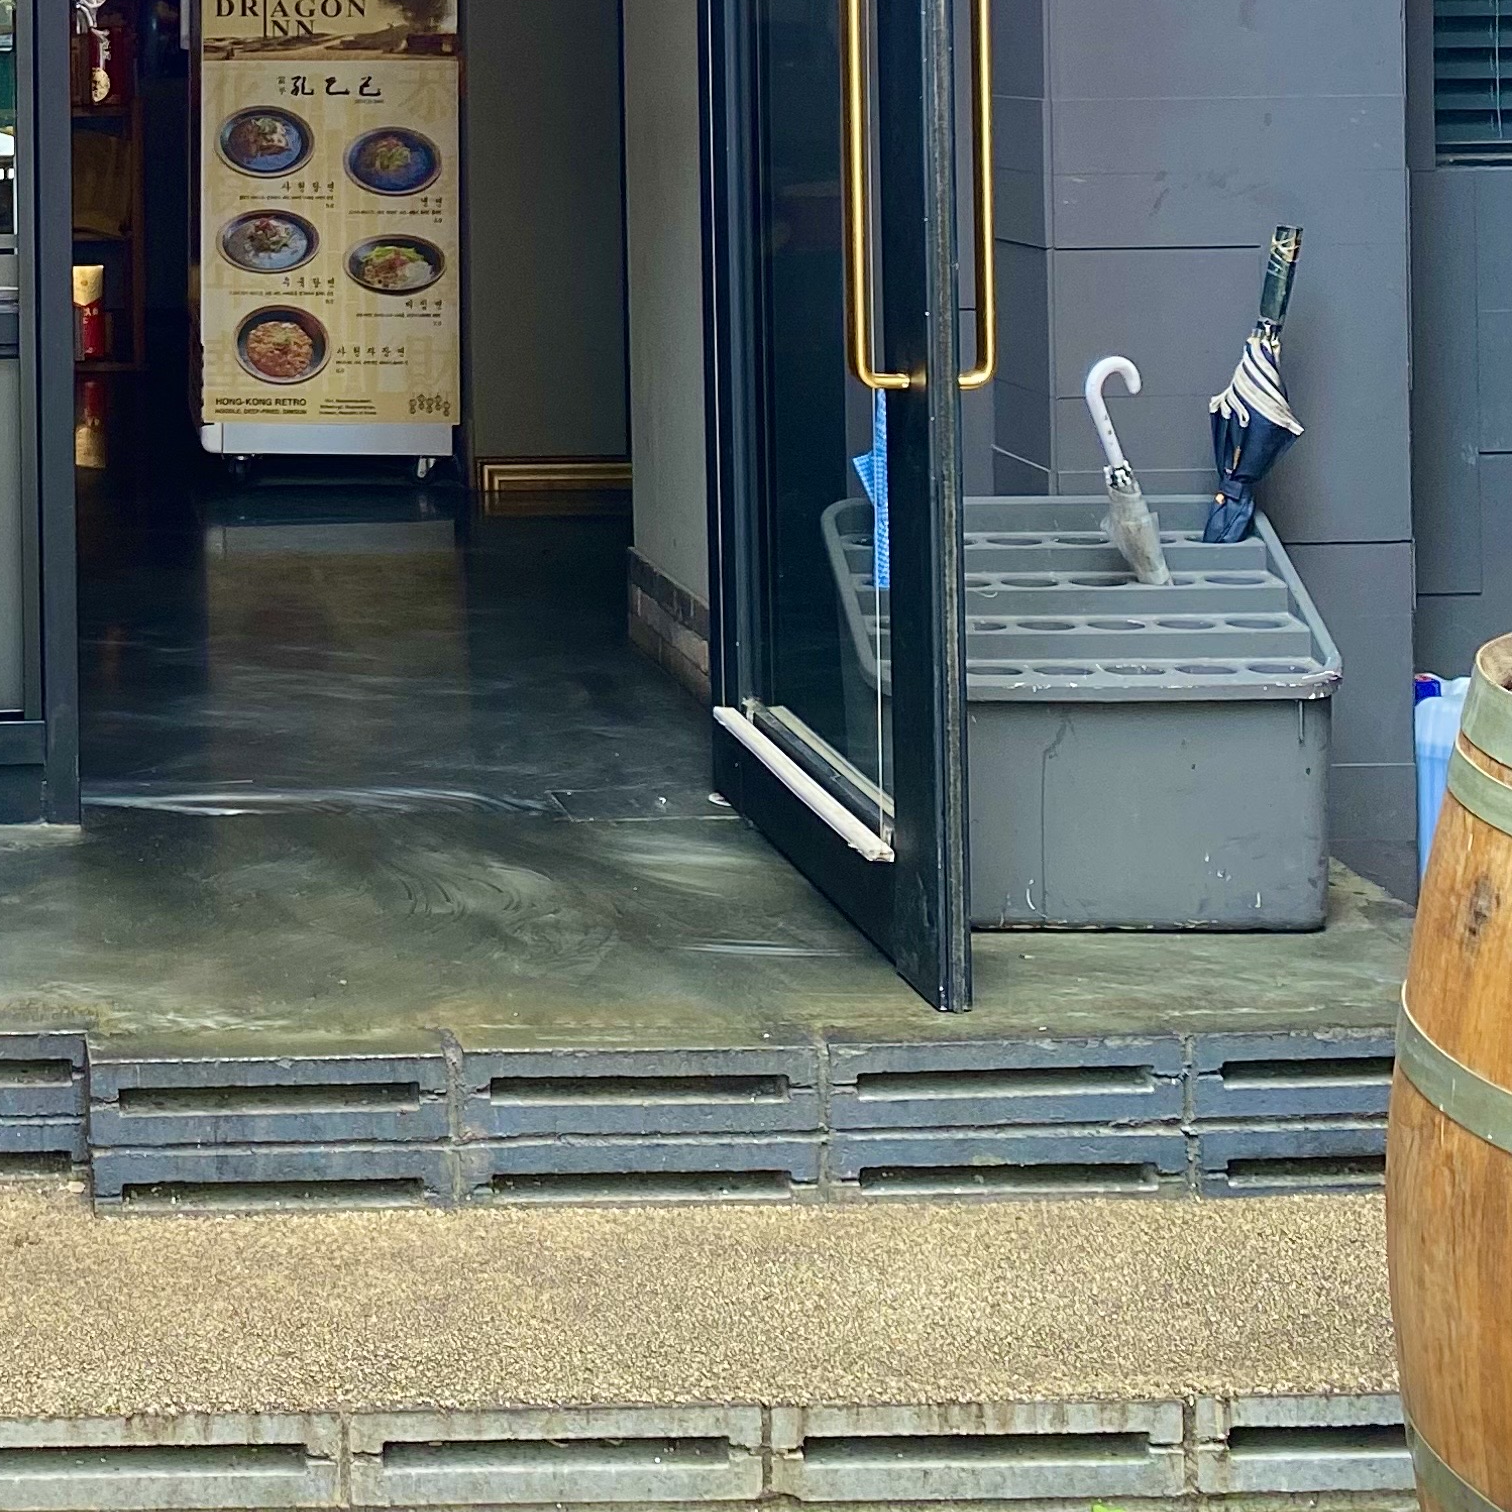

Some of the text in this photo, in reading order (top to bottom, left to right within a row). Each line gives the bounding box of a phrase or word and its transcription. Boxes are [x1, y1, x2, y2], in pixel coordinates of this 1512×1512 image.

[290, 75, 382, 97] 孔乙己
[215, 398, 307, 406] HONG-KONG RETRO
